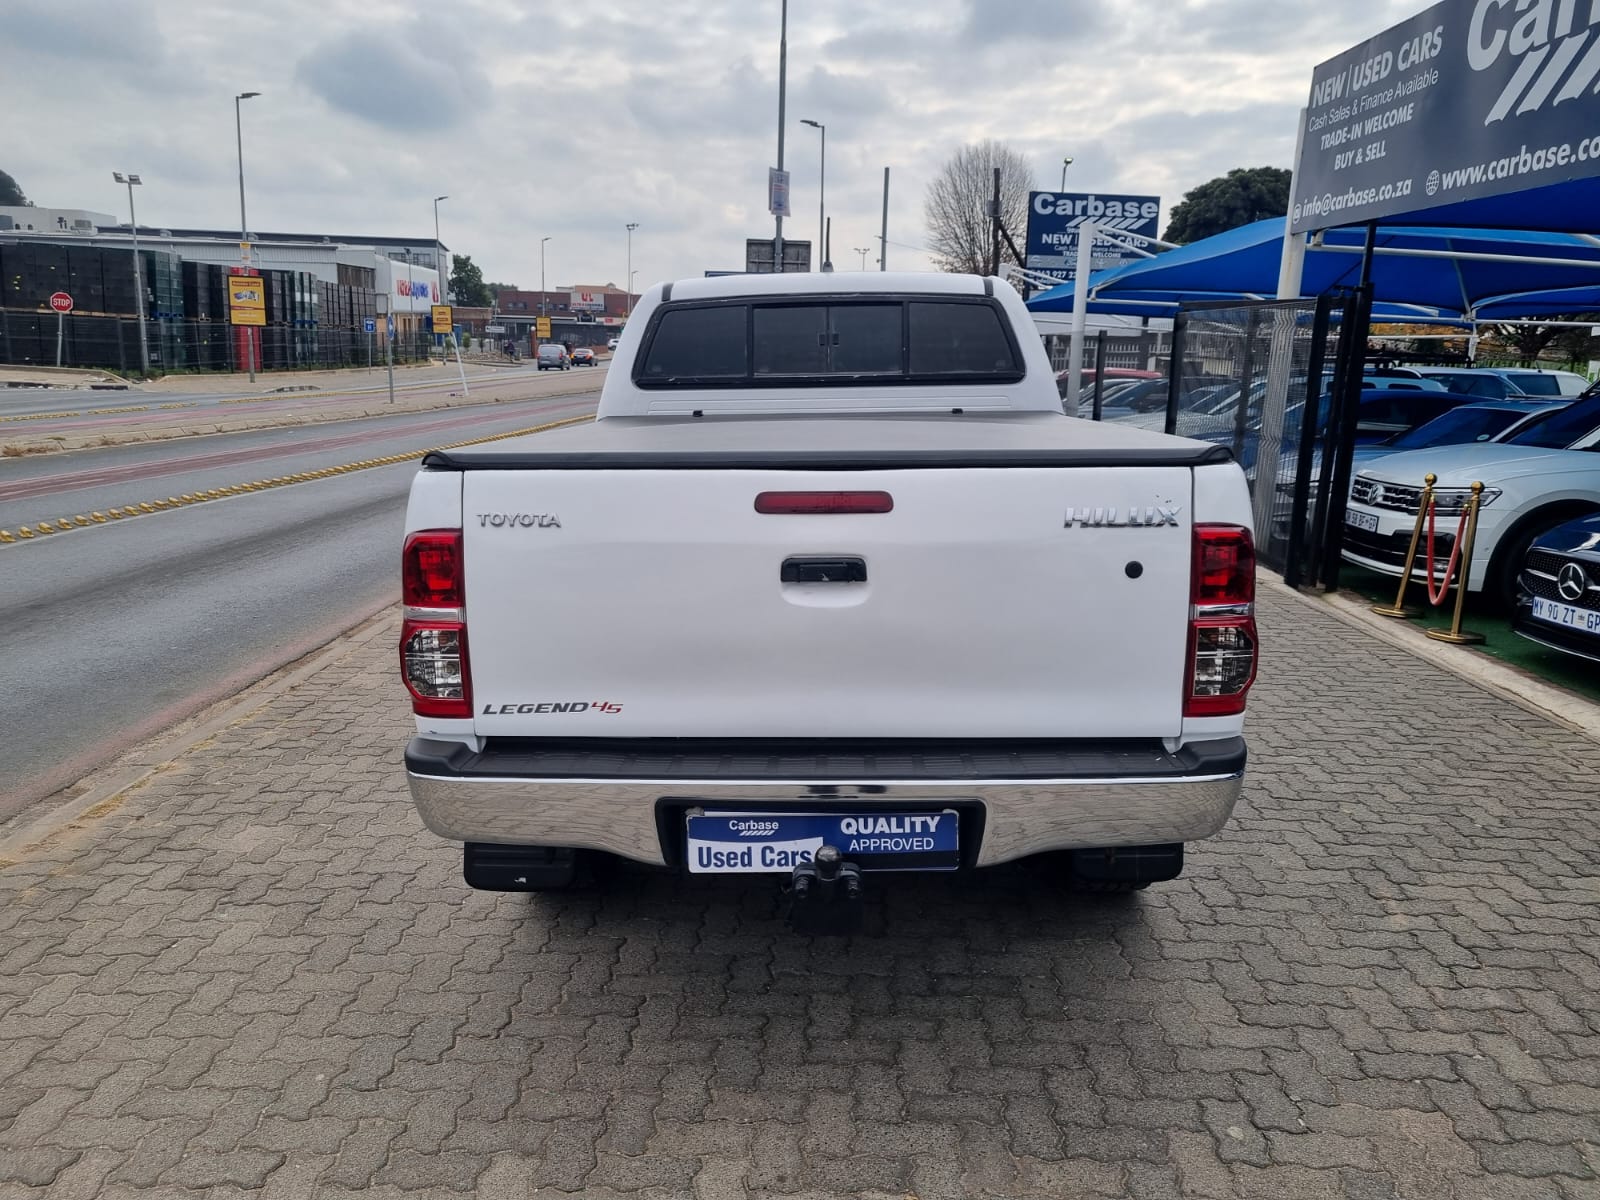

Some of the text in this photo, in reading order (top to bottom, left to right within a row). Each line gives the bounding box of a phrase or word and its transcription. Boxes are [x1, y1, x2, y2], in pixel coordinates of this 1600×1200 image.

[1312, 25, 1444, 108] NEW USED CARS
[1309, 67, 1439, 132] Cash Sales & Finance Available
[1320, 103, 1415, 150] TRADE-IN WELCOME
[1334, 140, 1386, 170] BUY & SELL
[1034, 193, 1158, 218] Carbase
[1302, 179, 1412, 216] info@carbase.co.za
[1042, 234, 1073, 245] NEW
[53, 298, 70, 306] STOP
[476, 512, 562, 528] TOYOTA
[1064, 507, 1182, 528] HILUX
[1563, 607, 1576, 624] ZT
[1587, 613, 1600, 630] GP
[729, 820, 779, 831] Carbase
[840, 816, 940, 835] QUALITY
[849, 837, 934, 851] APPROVED
[698, 845, 812, 868] Used Cars
